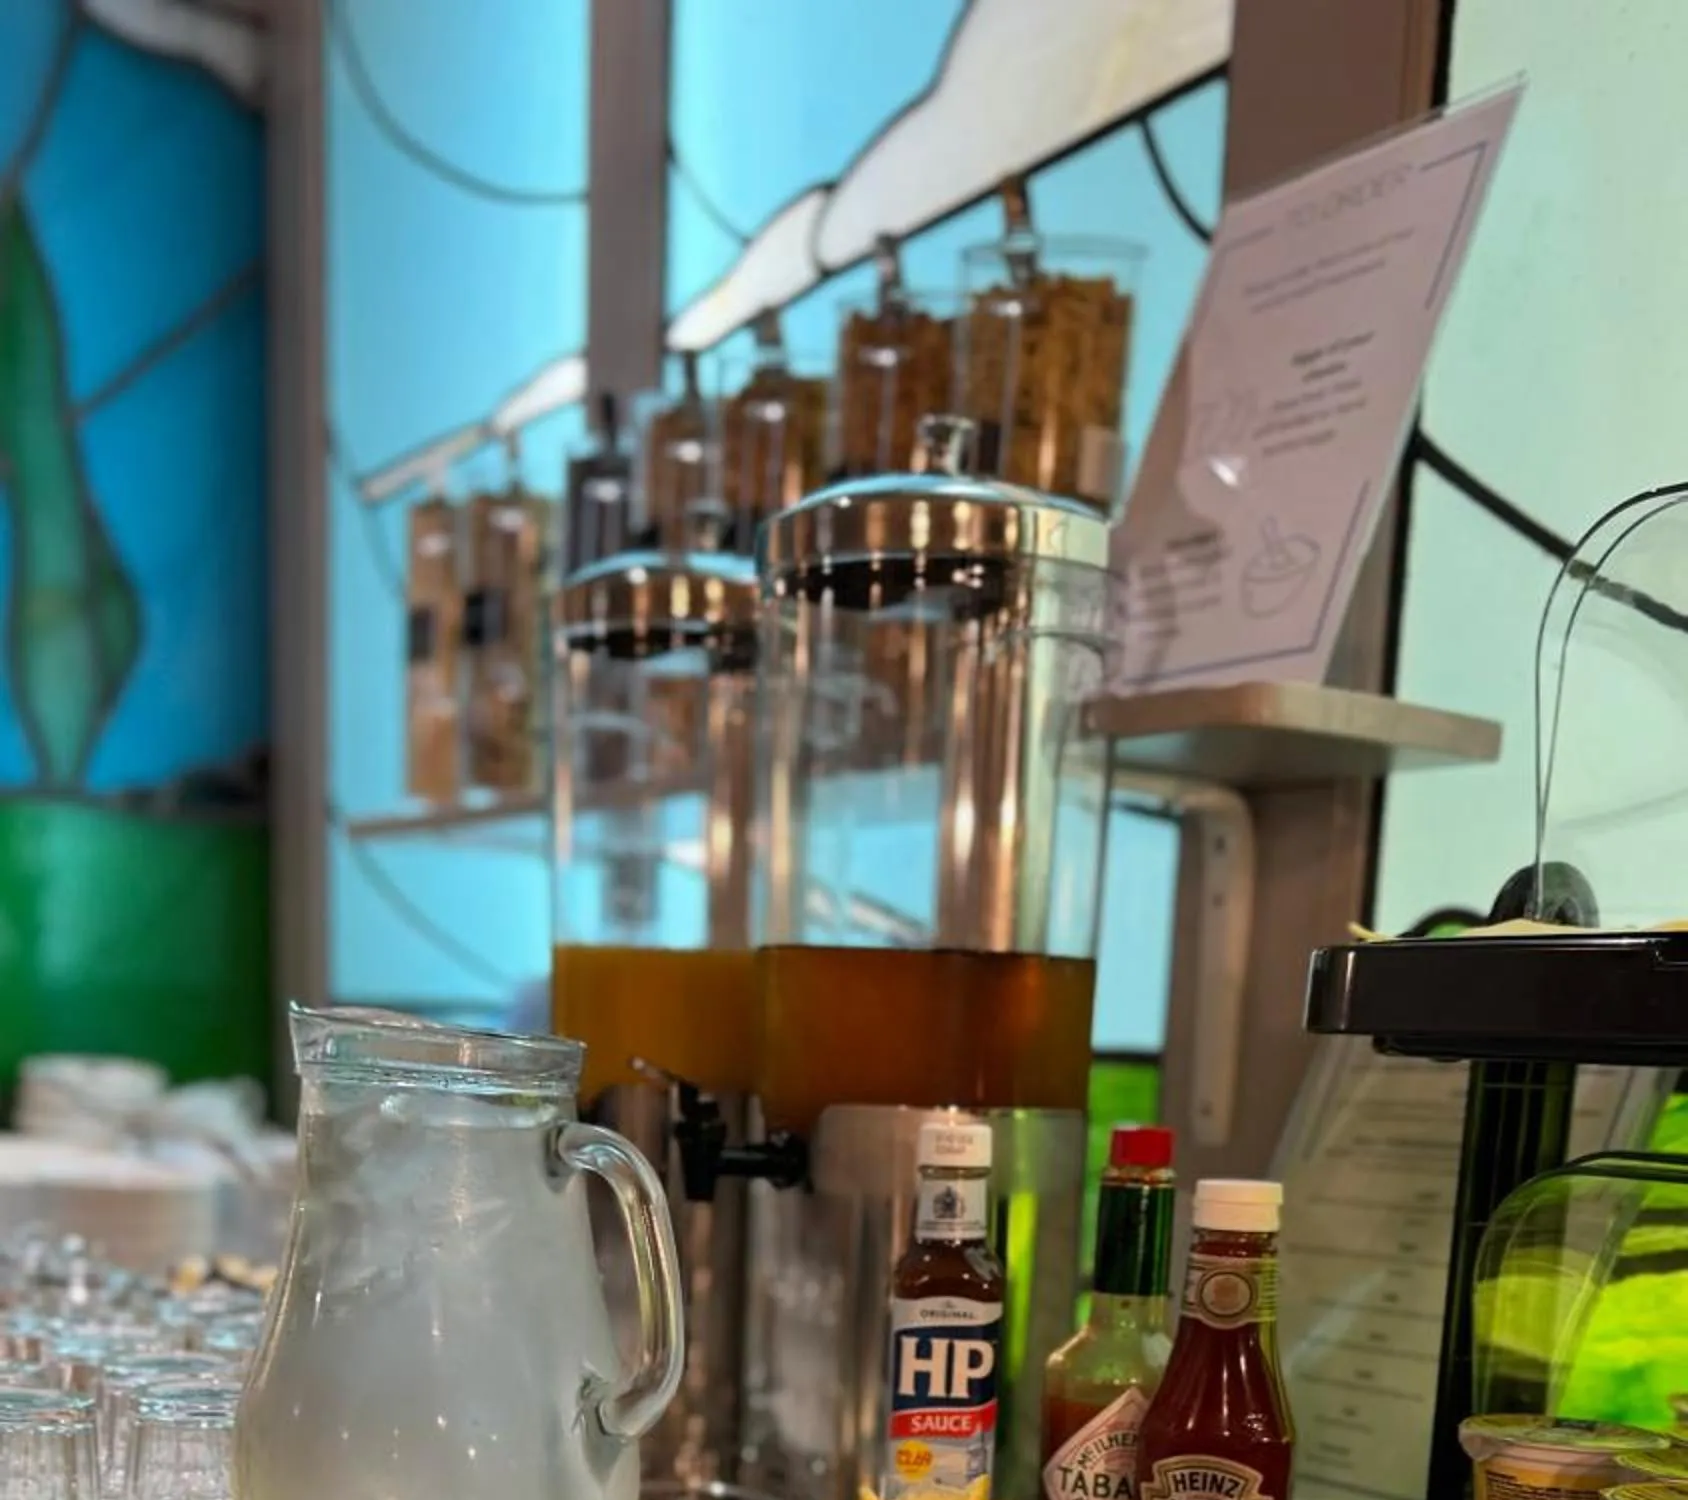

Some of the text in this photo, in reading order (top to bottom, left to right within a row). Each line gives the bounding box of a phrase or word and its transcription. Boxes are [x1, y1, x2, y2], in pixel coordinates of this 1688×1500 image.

[898, 1335, 995, 1399] HP
[911, 1415, 972, 1433] SAUCE
[1057, 1466, 1133, 1499] TABA
[1171, 1471, 1241, 1499] HEINZ
